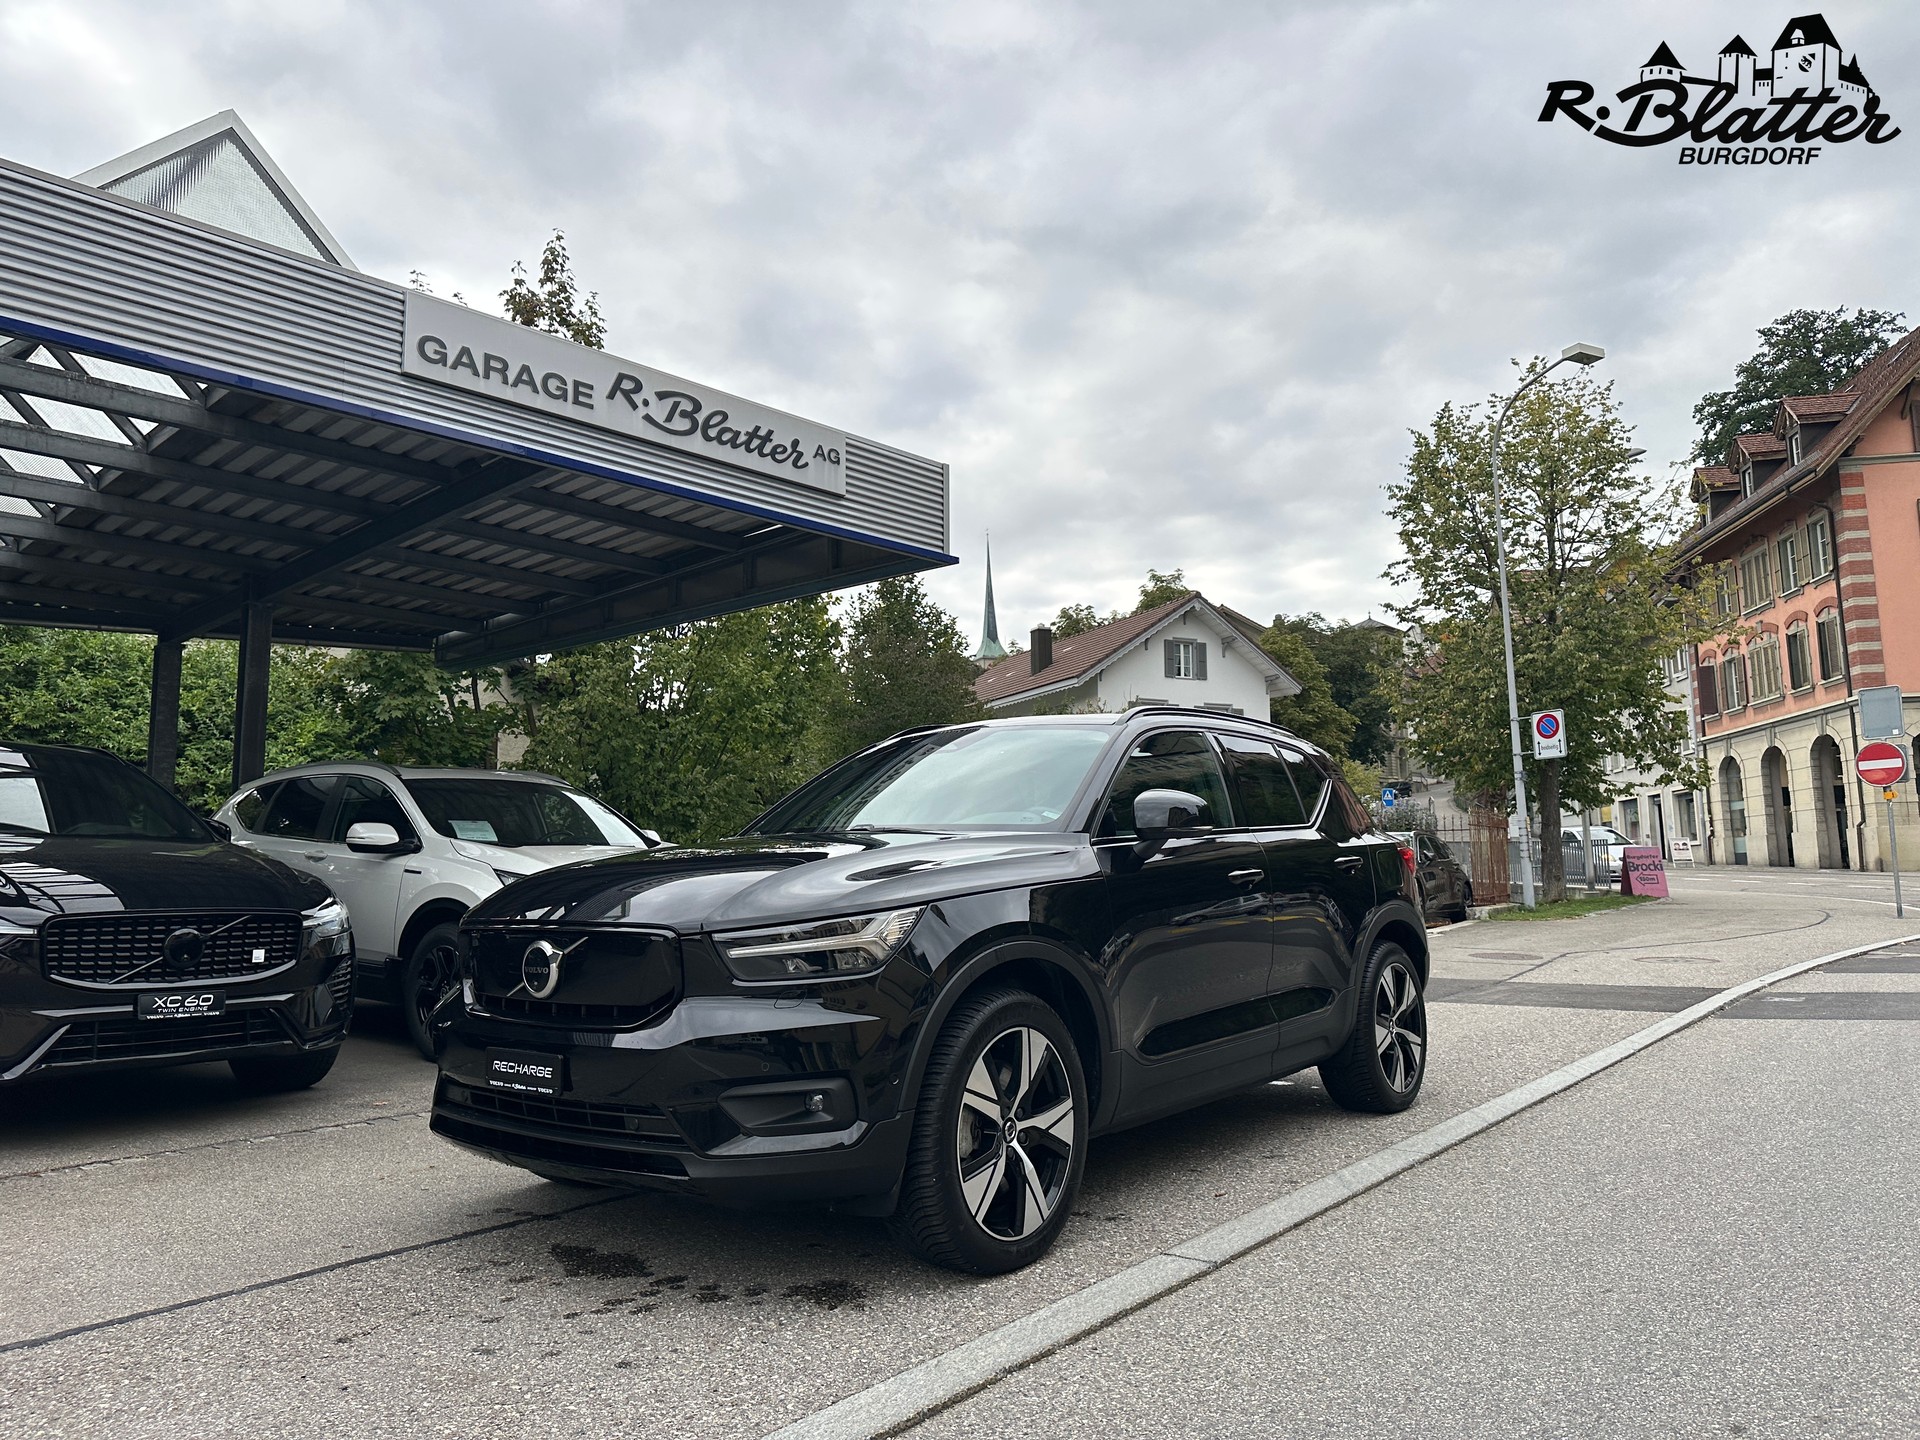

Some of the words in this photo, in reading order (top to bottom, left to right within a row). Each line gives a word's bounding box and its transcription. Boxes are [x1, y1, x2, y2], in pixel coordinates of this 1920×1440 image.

[417, 335, 595, 410] GARAGE
[813, 444, 841, 465] AG
[1628, 860, 1663, 872] Brocki
[525, 966, 549, 974] VOLVO
[492, 1060, 553, 1078] RECHARGE
